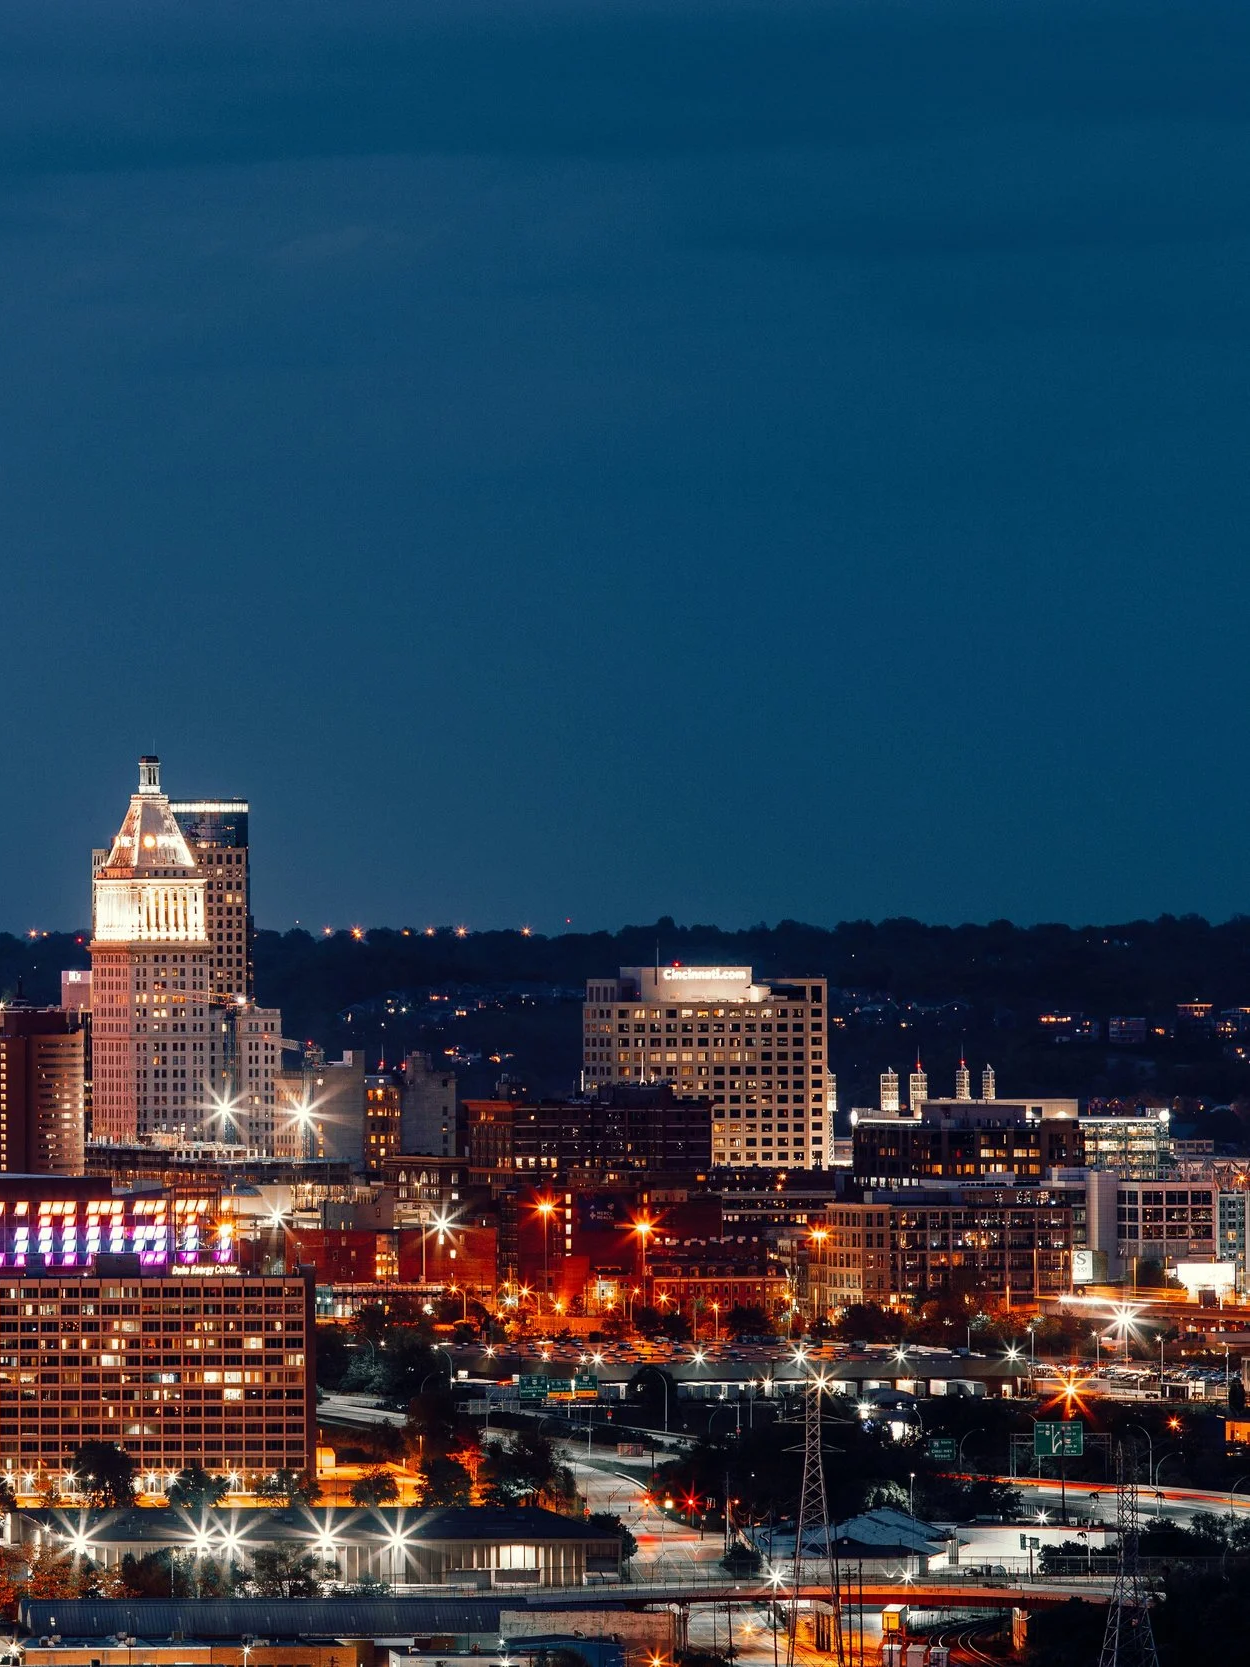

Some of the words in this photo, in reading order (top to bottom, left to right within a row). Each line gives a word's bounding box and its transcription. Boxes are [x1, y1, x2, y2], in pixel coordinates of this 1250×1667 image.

[663, 967, 747, 981] Cincinnati.com
[172, 1265, 190, 1275] Duke
[190, 1265, 214, 1276] Energy
[214, 1265, 238, 1275] Center
